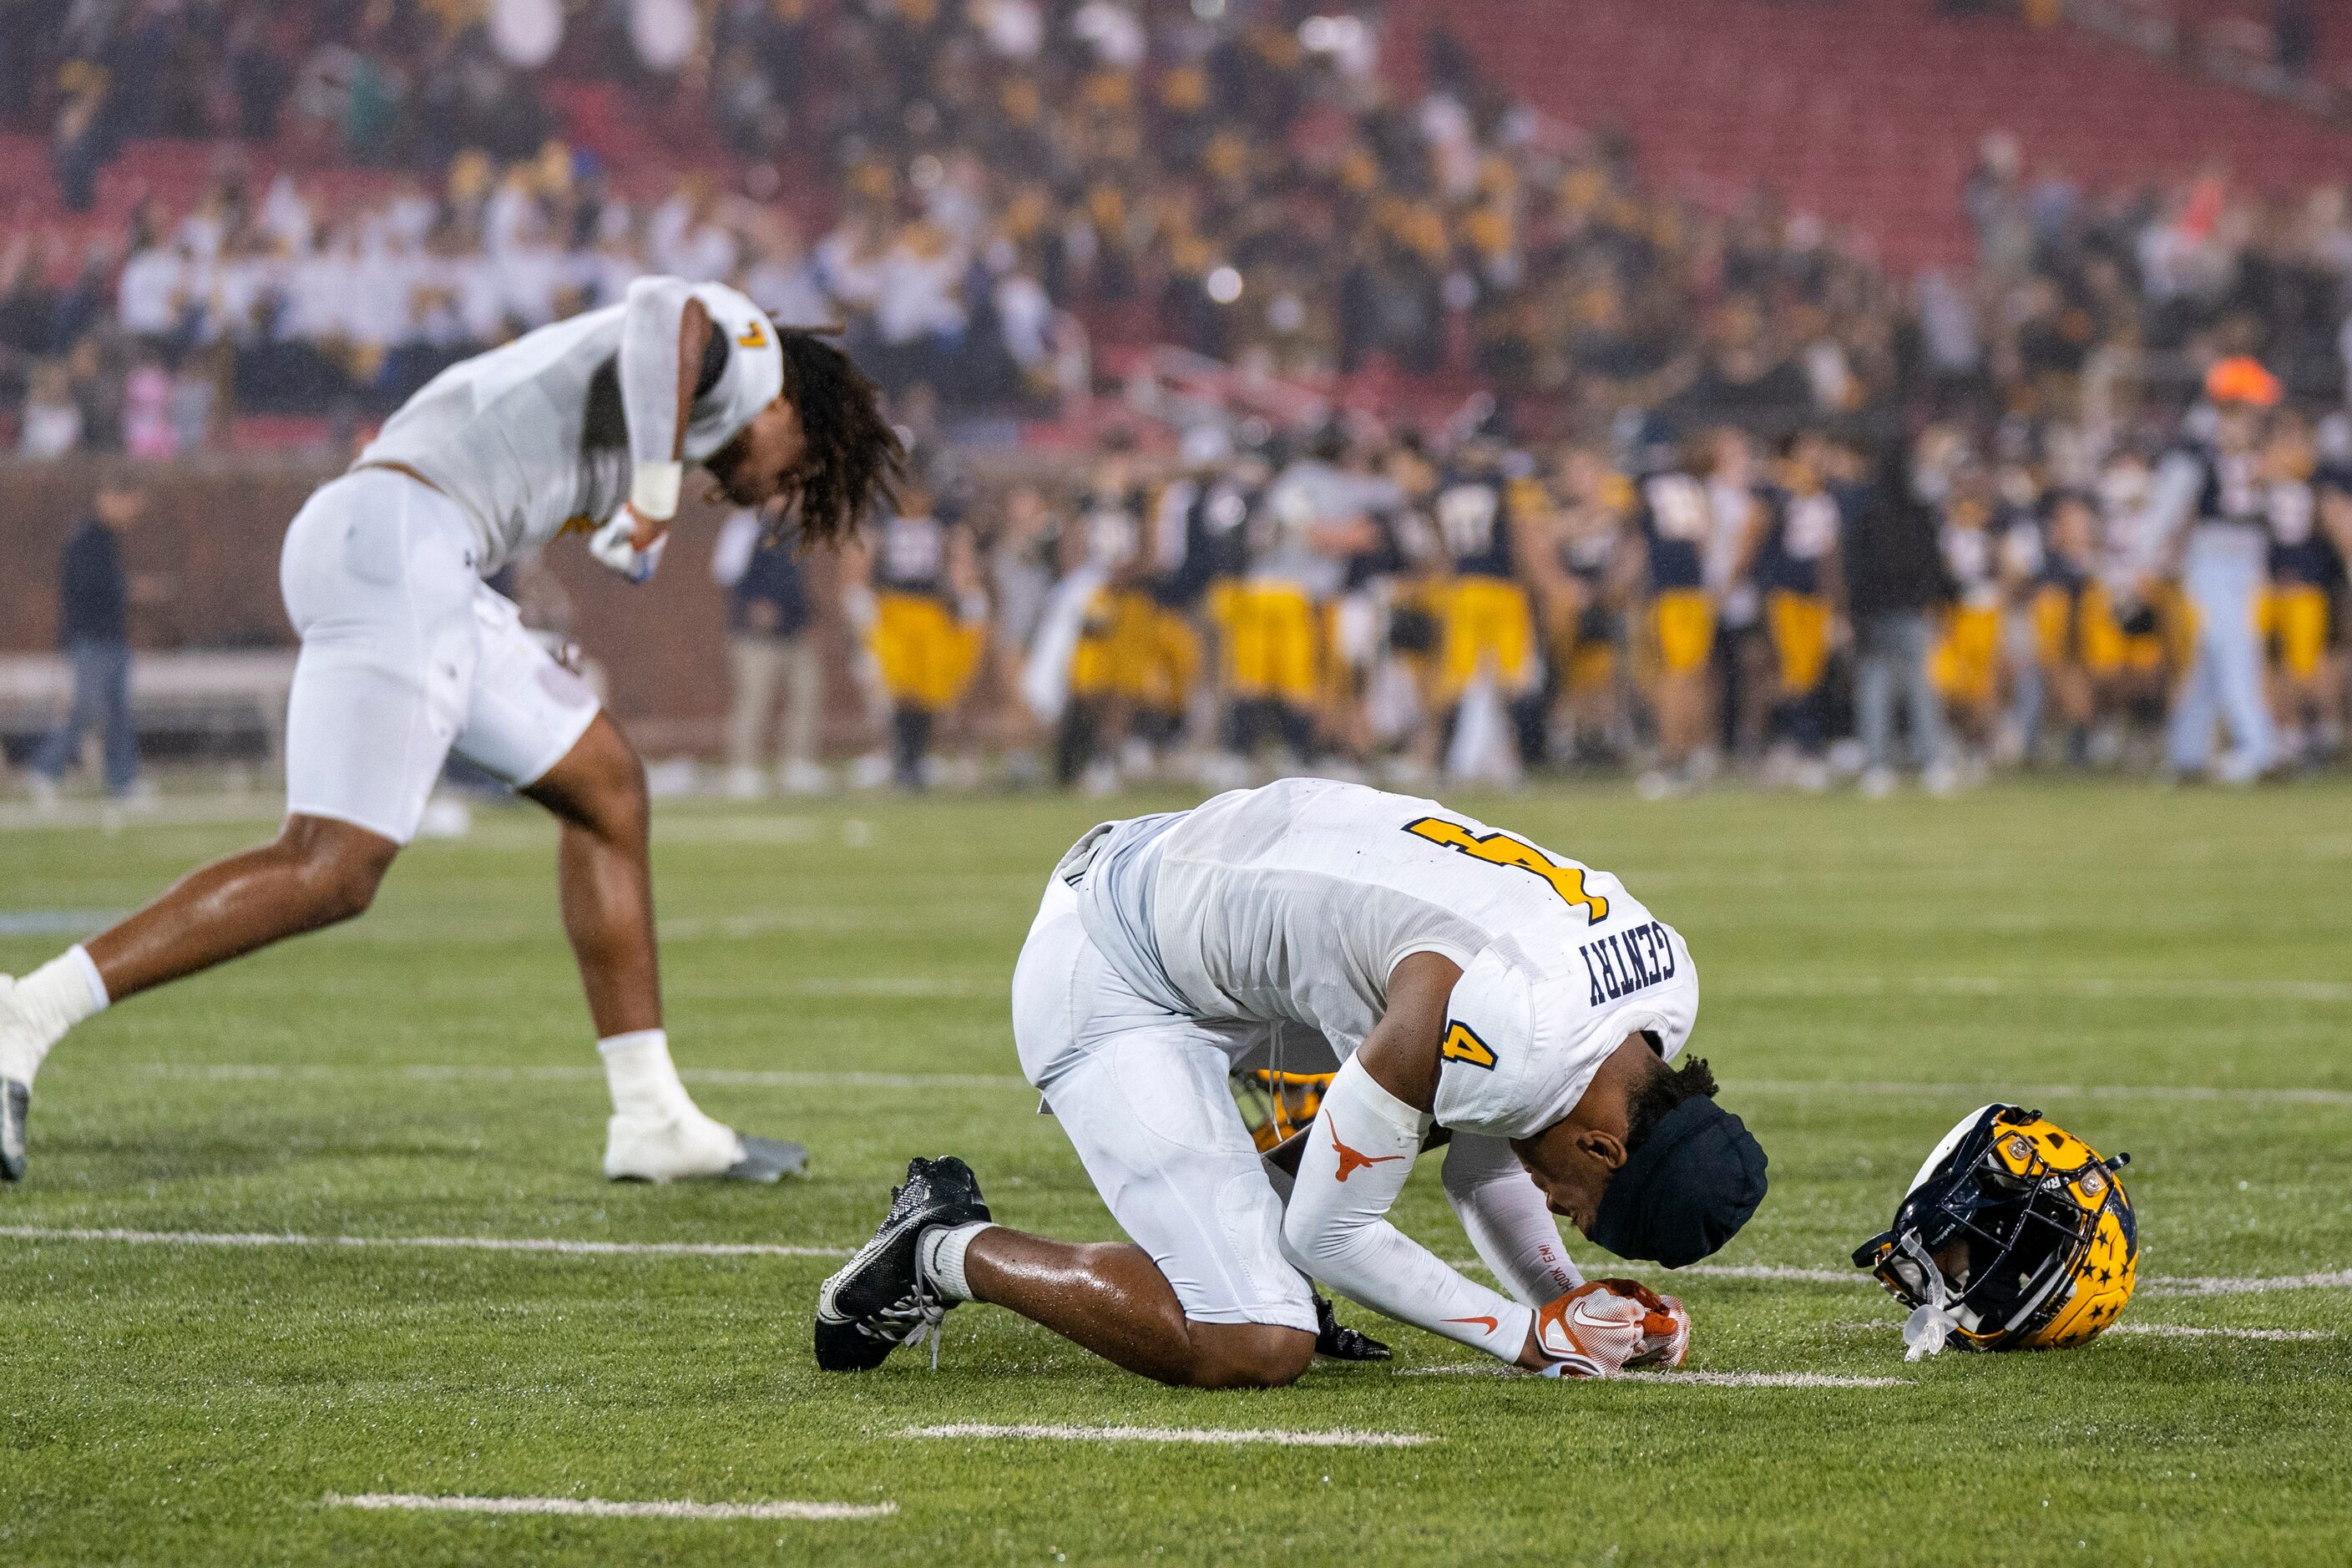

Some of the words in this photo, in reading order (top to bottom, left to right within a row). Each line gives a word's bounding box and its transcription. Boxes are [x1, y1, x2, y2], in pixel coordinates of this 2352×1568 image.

[1401, 817, 1609, 926] 4
[1579, 921, 1676, 1007] GENTRY
[1441, 1019, 1499, 1071] 4
[1549, 1266, 1575, 1294] HOOK
